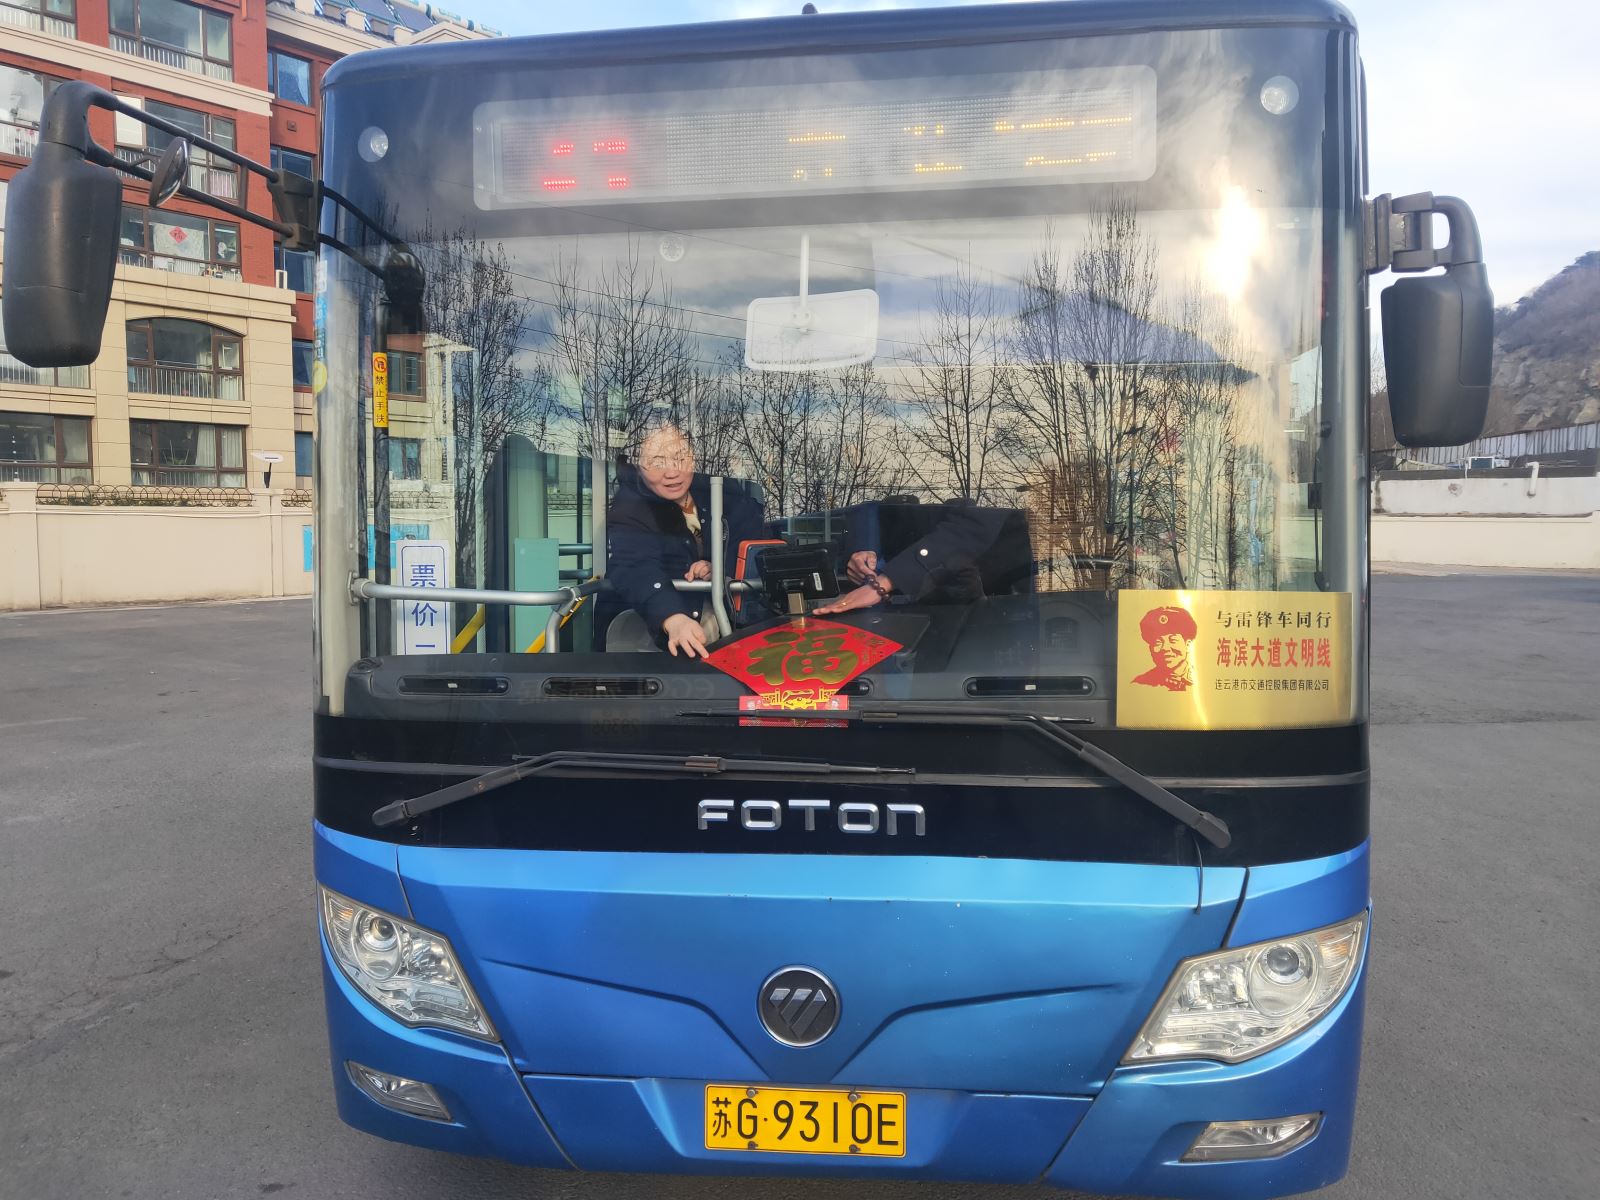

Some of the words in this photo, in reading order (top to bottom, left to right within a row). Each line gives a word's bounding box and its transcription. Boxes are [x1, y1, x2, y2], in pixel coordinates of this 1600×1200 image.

[375, 375, 385, 423] 禁止手扶
[1215, 610, 1332, 629] 与雷锋车同行
[746, 627, 860, 686] 福
[1216, 637, 1332, 668] 海滨大道文明线
[1215, 678, 1330, 692] 连云港市交通控股集团有限公司
[697, 799, 927, 837] FOTON
